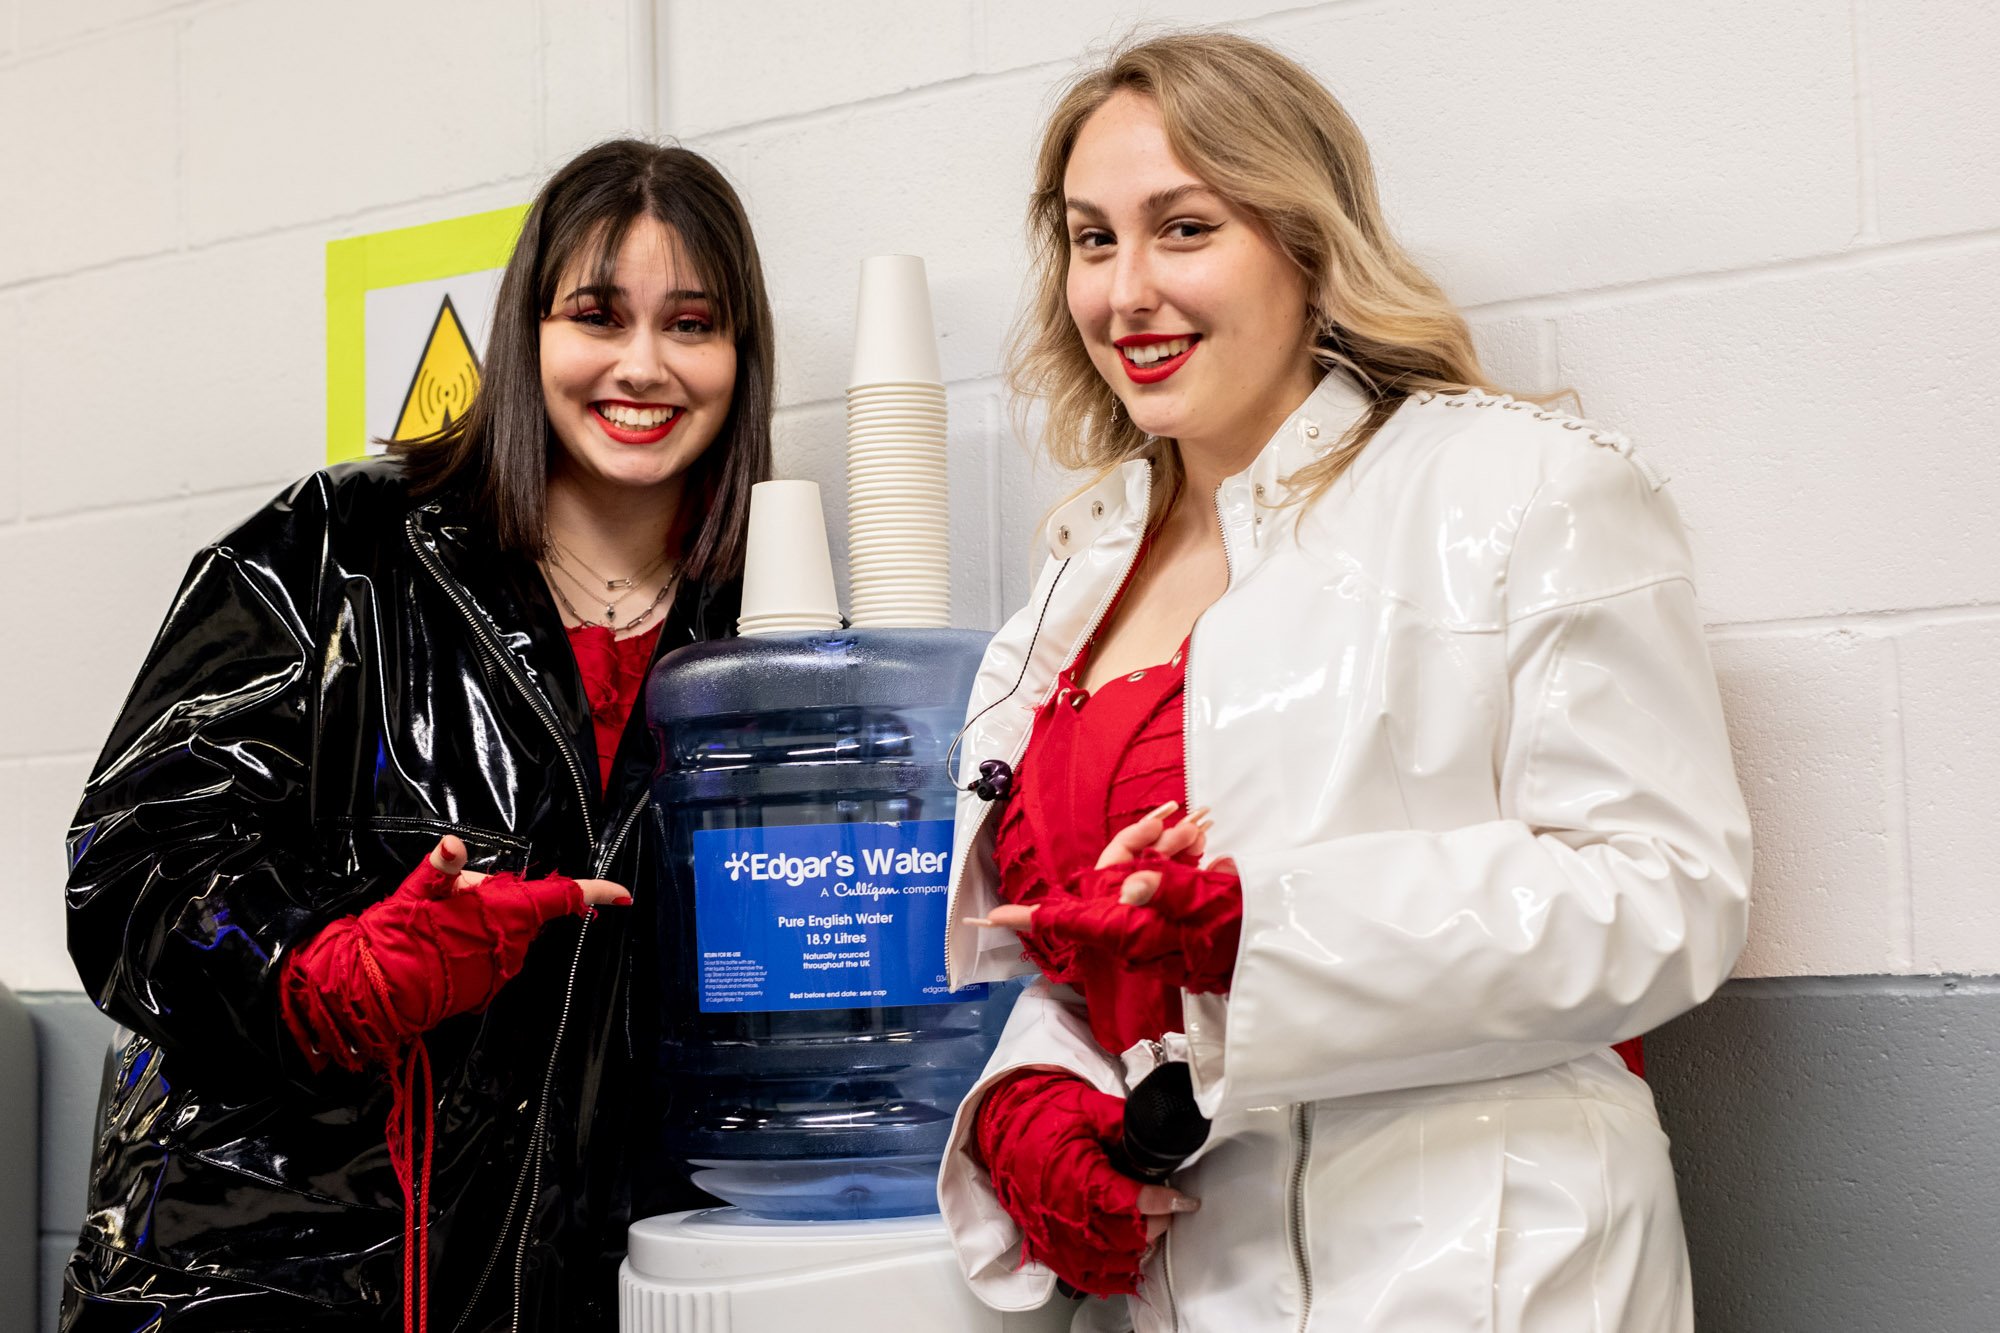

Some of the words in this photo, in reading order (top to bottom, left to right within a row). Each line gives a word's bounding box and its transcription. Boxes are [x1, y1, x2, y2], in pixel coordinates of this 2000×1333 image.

[751, 850, 855, 887] Edgar's
[862, 847, 948, 876] Water
[820, 888, 830, 898] A
[902, 884, 948, 896] company
[778, 916, 805, 928] Pure
[808, 914, 853, 929] English
[855, 912, 894, 925] Water
[806, 933, 832, 945] 18.9
[834, 932, 867, 944] Litres
[803, 952, 837, 961] Naturally
[838, 950, 870, 959] sourced
[803, 961, 844, 970] throughout
[845, 960, 858, 968] the
[859, 959, 871, 967] UK
[804, 991, 825, 999] before
[873, 990, 887, 998] cap
